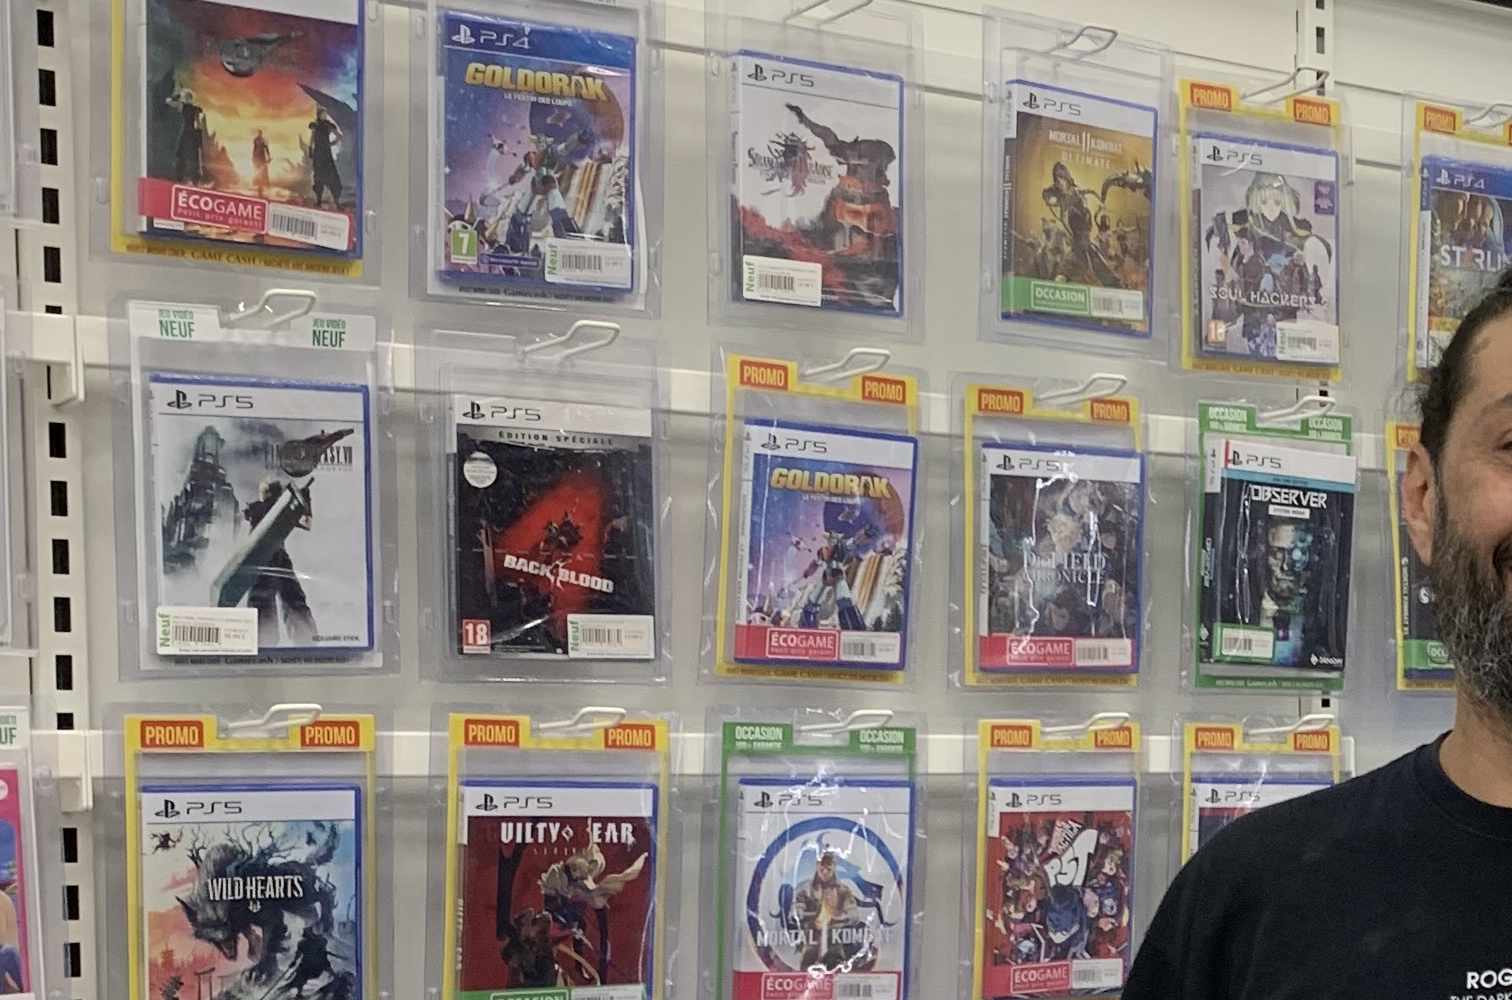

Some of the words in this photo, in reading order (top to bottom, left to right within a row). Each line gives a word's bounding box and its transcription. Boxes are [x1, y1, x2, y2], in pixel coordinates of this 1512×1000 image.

[480, 30, 530, 49] PS4
[465, 61, 608, 100] GOLDORAK
[772, 70, 815, 87] PS5
[1044, 99, 1082, 116] PS5
[1192, 88, 1230, 108] PROMO
[1295, 105, 1330, 123] PROMO
[1227, 151, 1263, 165] PS5
[1454, 174, 1486, 190] PS4
[177, 189, 264, 220] ÉCOGAME
[458, 232, 470, 255] 7
[745, 261, 756, 292] Neuf
[1035, 287, 1086, 303] OCCASION
[159, 320, 196, 339] NEUF
[312, 330, 346, 349] NEUF
[743, 366, 785, 388] PROMO
[864, 381, 903, 401] PROMO
[198, 394, 254, 410] PS5
[980, 392, 1021, 413] PROMO
[491, 405, 542, 423] PS5
[1208, 406, 1248, 422] OCCASION
[1308, 418, 1344, 432] OCCASION
[498, 430, 549, 442] ÉDITION
[555, 434, 615, 447] SPÉCIALE
[785, 438, 828, 454] PS5
[1246, 455, 1283, 469] PS5
[770, 467, 892, 499] GOLDORAK
[1250, 483, 1328, 509] OBSERVER
[504, 554, 551, 579] BACK
[559, 567, 615, 594] BLOOD
[158, 613, 172, 648] Neuf
[464, 623, 489, 647] 18
[570, 619, 581, 652] Neuf
[770, 630, 834, 650] ÉCOGAME
[145, 725, 199, 746] PROMO
[305, 725, 356, 746] PROMO
[467, 723, 517, 744] PROMO
[607, 727, 653, 748] PROMO
[735, 725, 782, 743] OCCASION
[859, 729, 905, 747] OCCASION
[993, 728, 1031, 747] PROMO
[187, 800, 243, 815] PS5
[503, 796, 554, 810] PS5
[1026, 793, 1062, 805] PS5
[208, 877, 244, 901] WILD
[246, 874, 304, 900] HEARTS
[757, 929, 817, 947] MORTAL
[1013, 967, 1068, 983] ÉCOGAME
